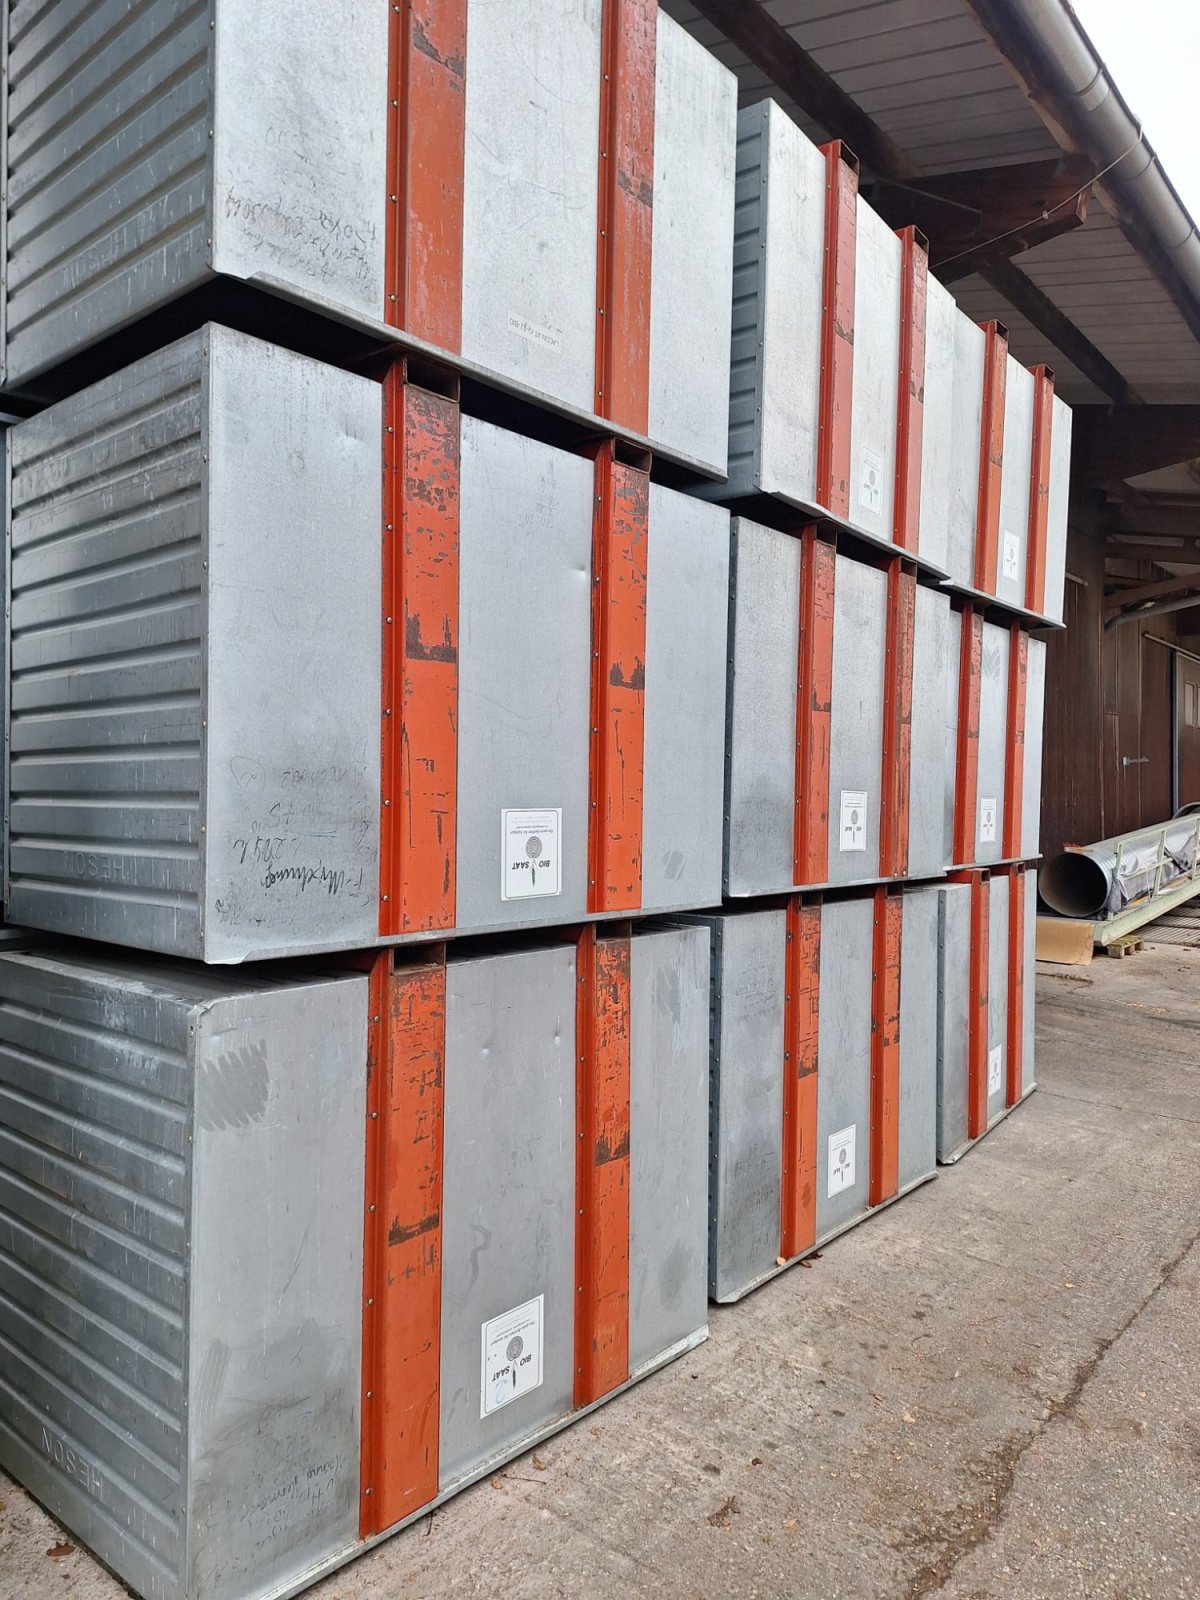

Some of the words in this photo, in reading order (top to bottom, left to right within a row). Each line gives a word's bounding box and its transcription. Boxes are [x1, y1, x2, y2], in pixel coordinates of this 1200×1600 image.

[64, 850, 126, 883] HESON
[512, 861, 530, 870] SAAT
[539, 859, 550, 867] BIO
[519, 1354, 532, 1366] BIO
[491, 1366, 511, 1382] SAAT
[42, 1427, 103, 1503] HESON
